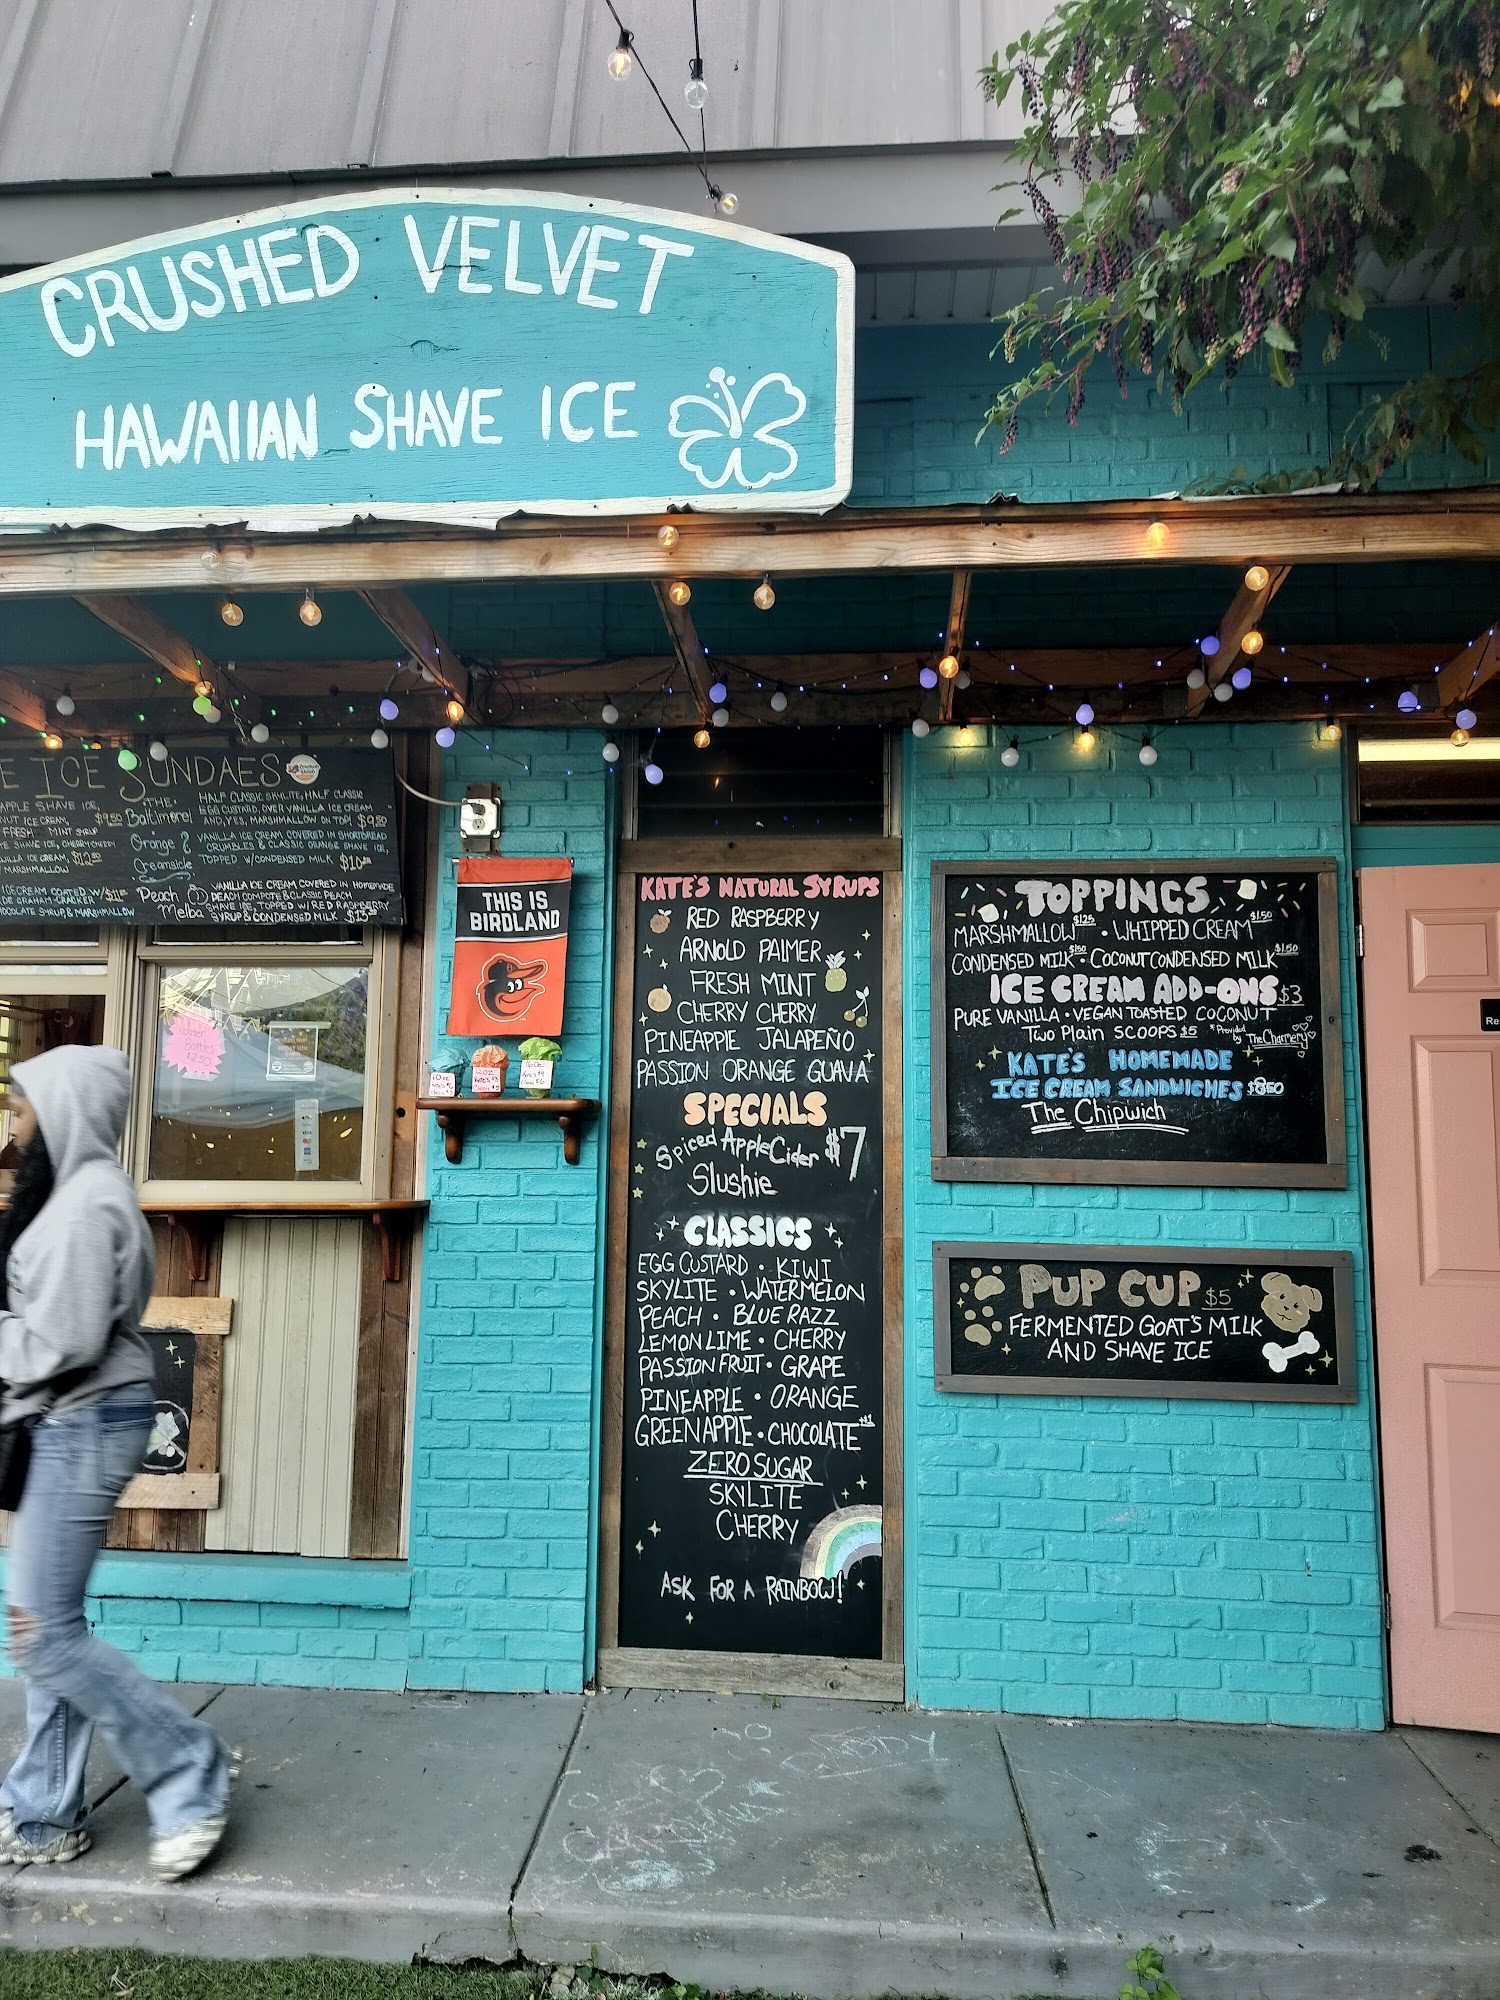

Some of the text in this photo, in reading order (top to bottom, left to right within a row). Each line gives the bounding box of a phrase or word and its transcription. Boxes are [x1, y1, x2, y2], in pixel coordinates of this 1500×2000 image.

[41, 215, 695, 357] CRUSHED VELVET
[75, 381, 638, 471] HAWAIIAN SHAVE ICE
[30, 755, 105, 799] ICE
[119, 752, 281, 802] SUNDAES
[35, 800, 76, 813] SHAVE
[199, 789, 363, 804] HALF CLASSIC HALF CLASSIC
[286, 803, 373, 814] VANILLA ICE CREAM
[3, 826, 34, 839] FRESH
[48, 827, 73, 837] MINT
[250, 815, 331, 825] MARSHMALLOW ON
[130, 832, 176, 857] Orange
[207, 839, 266, 852] CRUMBLES &
[286, 829, 324, 840] COVERED
[327, 830, 335, 839] IN
[3, 866, 69, 874] MARSHMALLOW
[133, 856, 193, 875] Creamsicle
[198, 854, 334, 865] TOPPED MILK
[136, 884, 180, 903] Peach
[266, 880, 298, 890] CREAM
[298, 879, 337, 888] COVERED
[340, 881, 348, 889] IN
[641, 874, 880, 901] KATE'S NATURAL SYRUPS
[1015, 876, 1210, 917] TOPPINGS
[157, 902, 205, 922] Melba
[311, 901, 389, 911] RED RASPBERRY
[482, 891, 548, 912] THIS IS
[210, 909, 338, 923] SYRUP & CONDENSED MILK
[470, 909, 560, 932] BIRDLAND
[686, 906, 820, 930] RED RASPBERRY
[954, 921, 1076, 948] MARSHMALLOW
[1112, 918, 1190, 942] WHIPPED
[1193, 918, 1253, 941] CREAM
[680, 936, 822, 963] ARNOLD PALMER
[951, 952, 1034, 976] CONDENSED
[1039, 950, 1076, 969] MILK
[1090, 948, 1150, 969] COCONUT
[1150, 950, 1230, 970] CONDENSED
[1236, 949, 1278, 969] MILK
[690, 970, 817, 997] FRESH MINT
[990, 972, 1305, 1006] ICE CREAM ADD-ONS $3
[677, 1000, 817, 1024] CHERRY CHERRY
[954, 1005, 1278, 1031] PURE VANILLA VEGAN TOASTED COCONUT
[644, 1026, 855, 1054] PINEAPPLE JALAPEÑO
[1021, 1025, 1055, 1043] Two
[1061, 1025, 1104, 1042] Plain
[1180, 1026, 1198, 1039] $5
[1233, 1031, 1242, 1044] by
[637, 1058, 870, 1089] PASSION ORANGE GUAVA
[1007, 1047, 1233, 1077] KATE'S HOMEMADE
[990, 1078, 1041, 1100] ICE
[1043, 1077, 1112, 1099] CREAM
[1118, 1076, 1244, 1101] SANDWICHES
[683, 1090, 828, 1127] SPECIALS
[1021, 1098, 1166, 1129] The Chipwich
[655, 1127, 717, 1170] Spiced
[824, 1126, 867, 1182] $7
[687, 1161, 778, 1199] Slushie
[683, 1215, 813, 1251] CLASSICS
[638, 1251, 833, 1283] EGG CUSTARD KIWI
[636, 1277, 865, 1302] SKYLITE WATERMELON
[1019, 1264, 1234, 1311] PUP CUP $5
[638, 1303, 840, 1333] PEACH BLUE RAZZ
[1008, 1313, 1264, 1338] FERMENTED GOAT'S MILK
[638, 1328, 846, 1354] LEMON LIME CHERRY
[1047, 1340, 1213, 1363] AND SHAVE ICE
[639, 1353, 846, 1386] PASSION FRUIT GRAPE
[640, 1383, 859, 1414] PINEAPPLE ORANGE
[767, 1420, 862, 1451] CHOCOLATE
[687, 1450, 813, 1483] ZERO SUGAR
[708, 1480, 804, 1510] SKYLITE
[716, 1508, 799, 1545] CHERRY
[661, 1570, 843, 1606] ASK FOR A RAINBOW!
